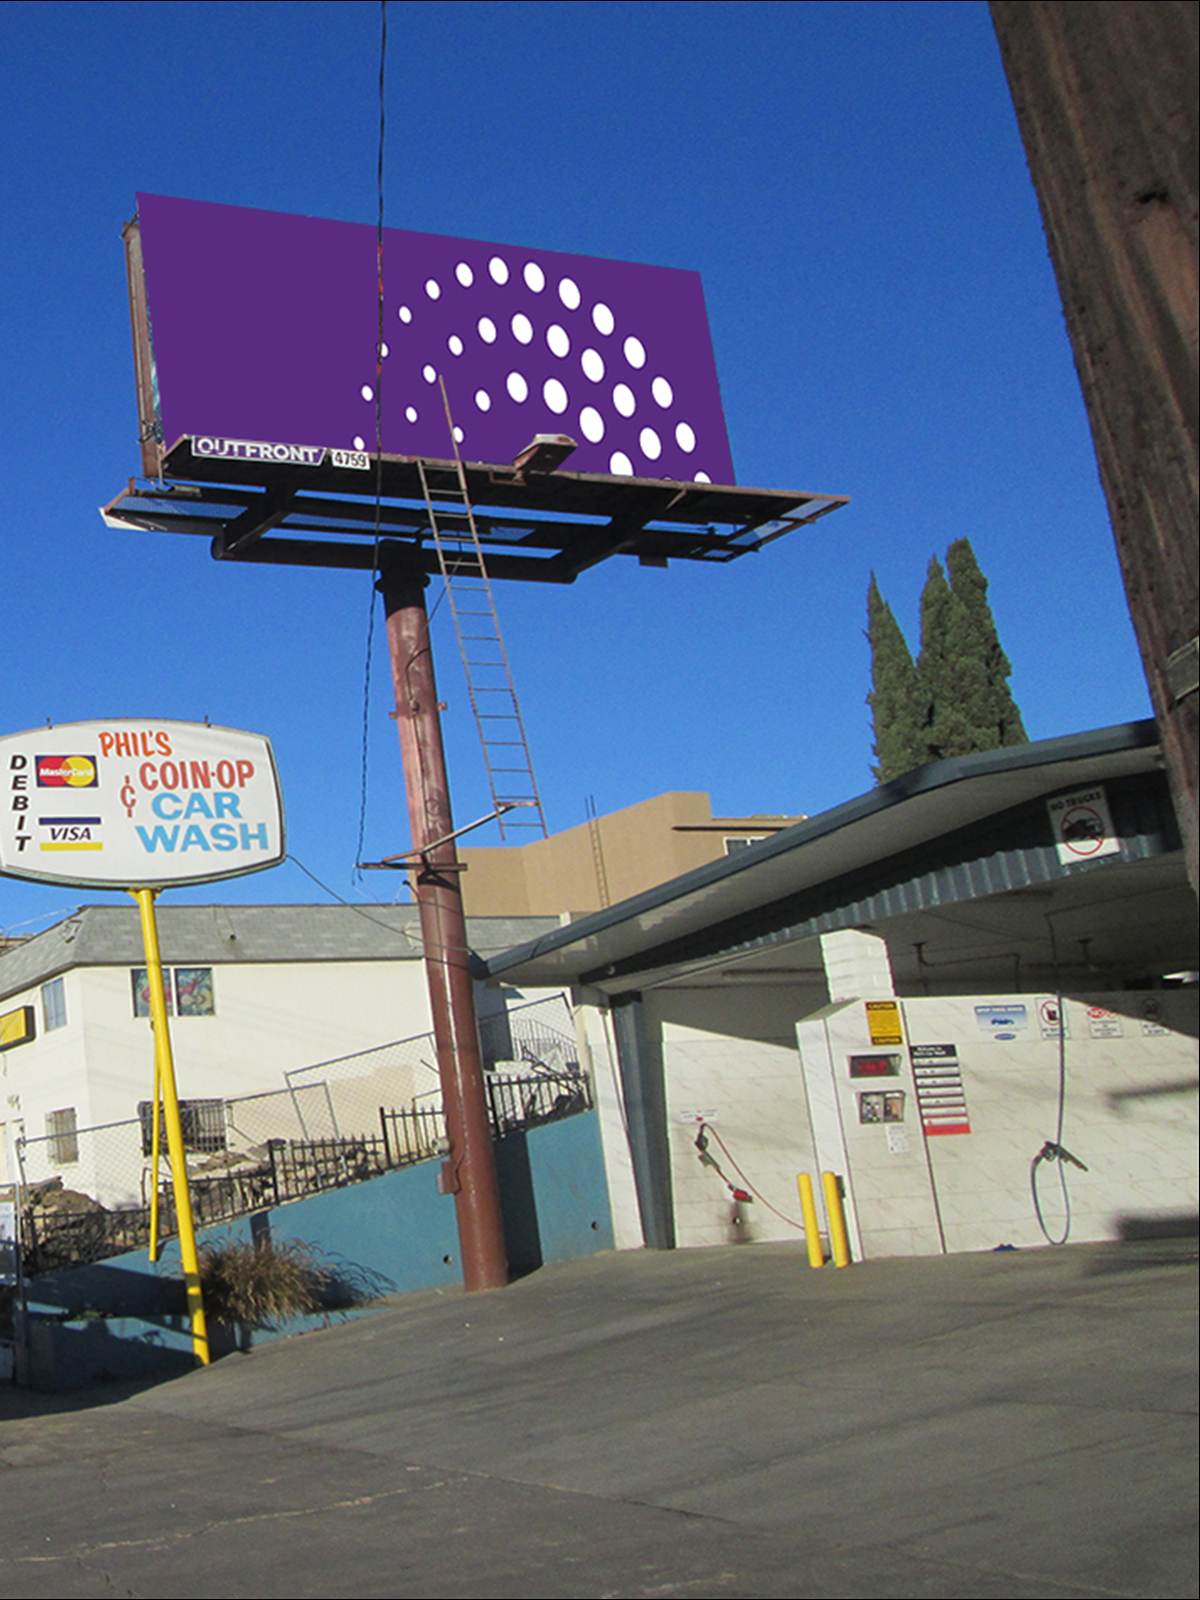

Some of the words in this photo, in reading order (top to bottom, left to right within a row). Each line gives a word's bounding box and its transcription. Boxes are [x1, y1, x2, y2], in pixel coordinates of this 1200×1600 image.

[197, 437, 318, 463] OUTFRONT
[334, 450, 367, 468] 4759
[98, 730, 172, 757] PHIL'S
[39, 767, 93, 777] MasterCard
[10, 754, 31, 851] DEBIT
[151, 791, 243, 820] CAR
[49, 826, 92, 841] VISA
[134, 822, 269, 853] WASH
